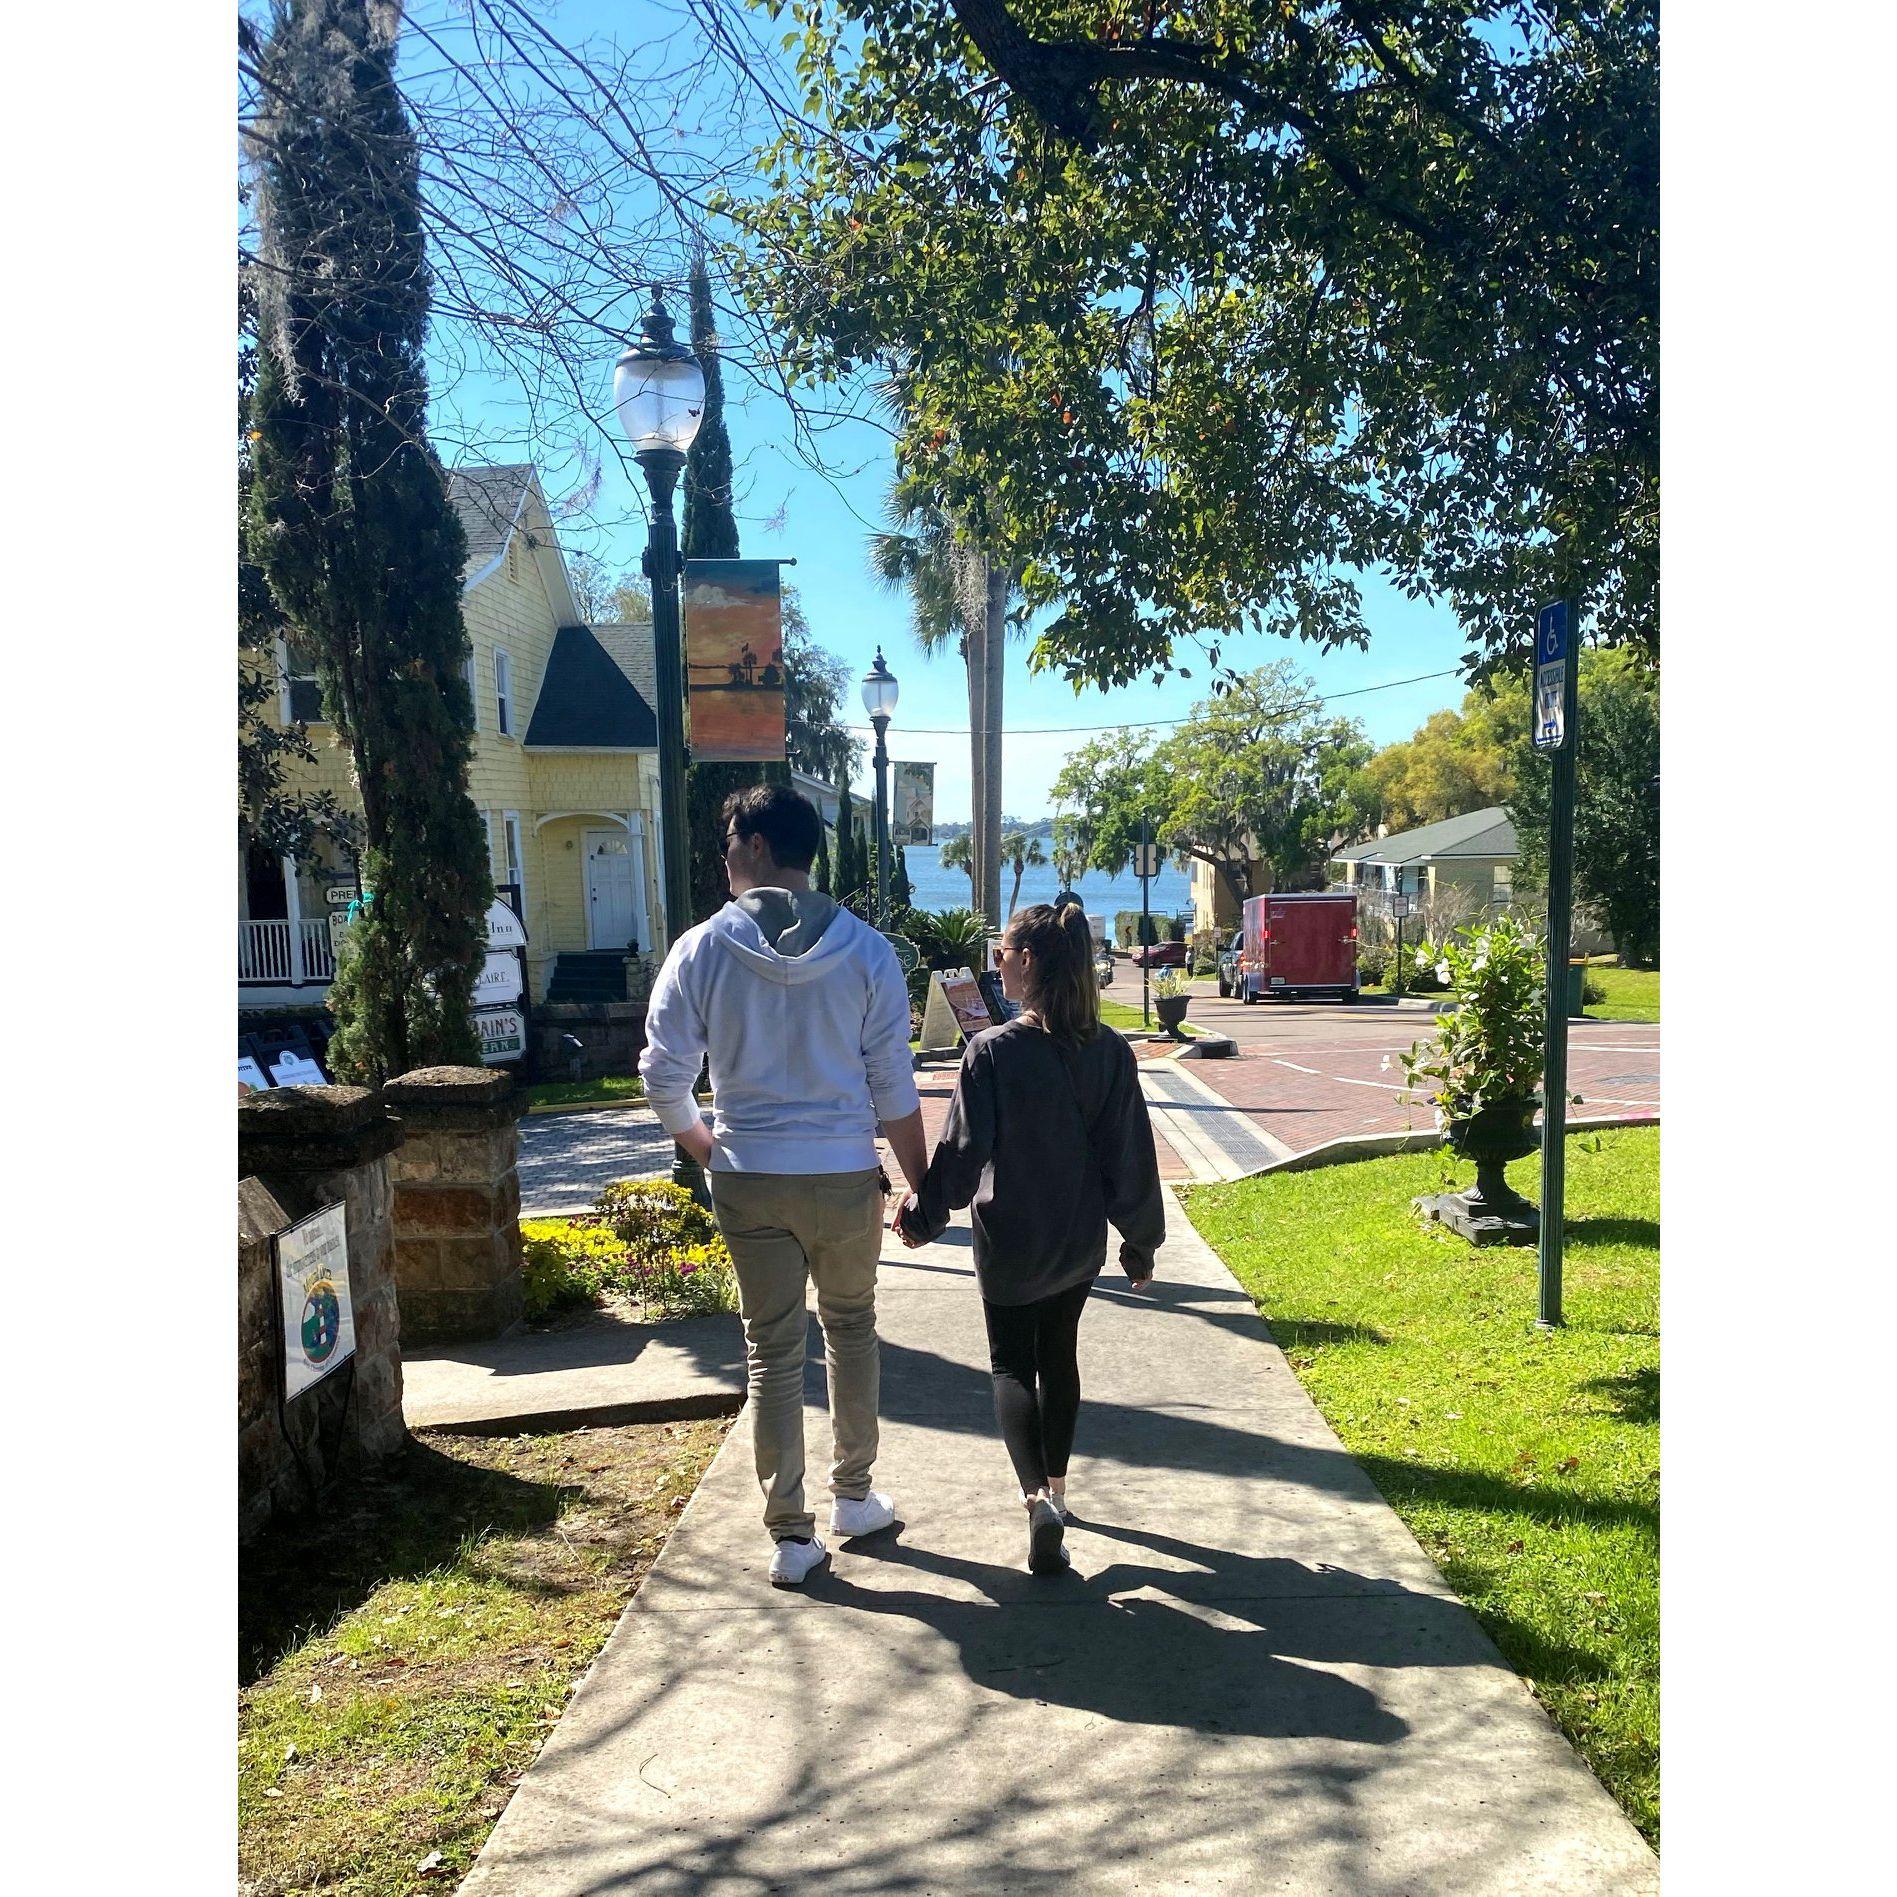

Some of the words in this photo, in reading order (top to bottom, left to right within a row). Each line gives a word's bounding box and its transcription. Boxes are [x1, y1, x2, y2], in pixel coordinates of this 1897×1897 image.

[330, 890, 356, 900] PRE
[332, 914, 348, 925] BOA
[479, 971, 508, 985] LAIRE
[482, 1040, 509, 1053] ERN
